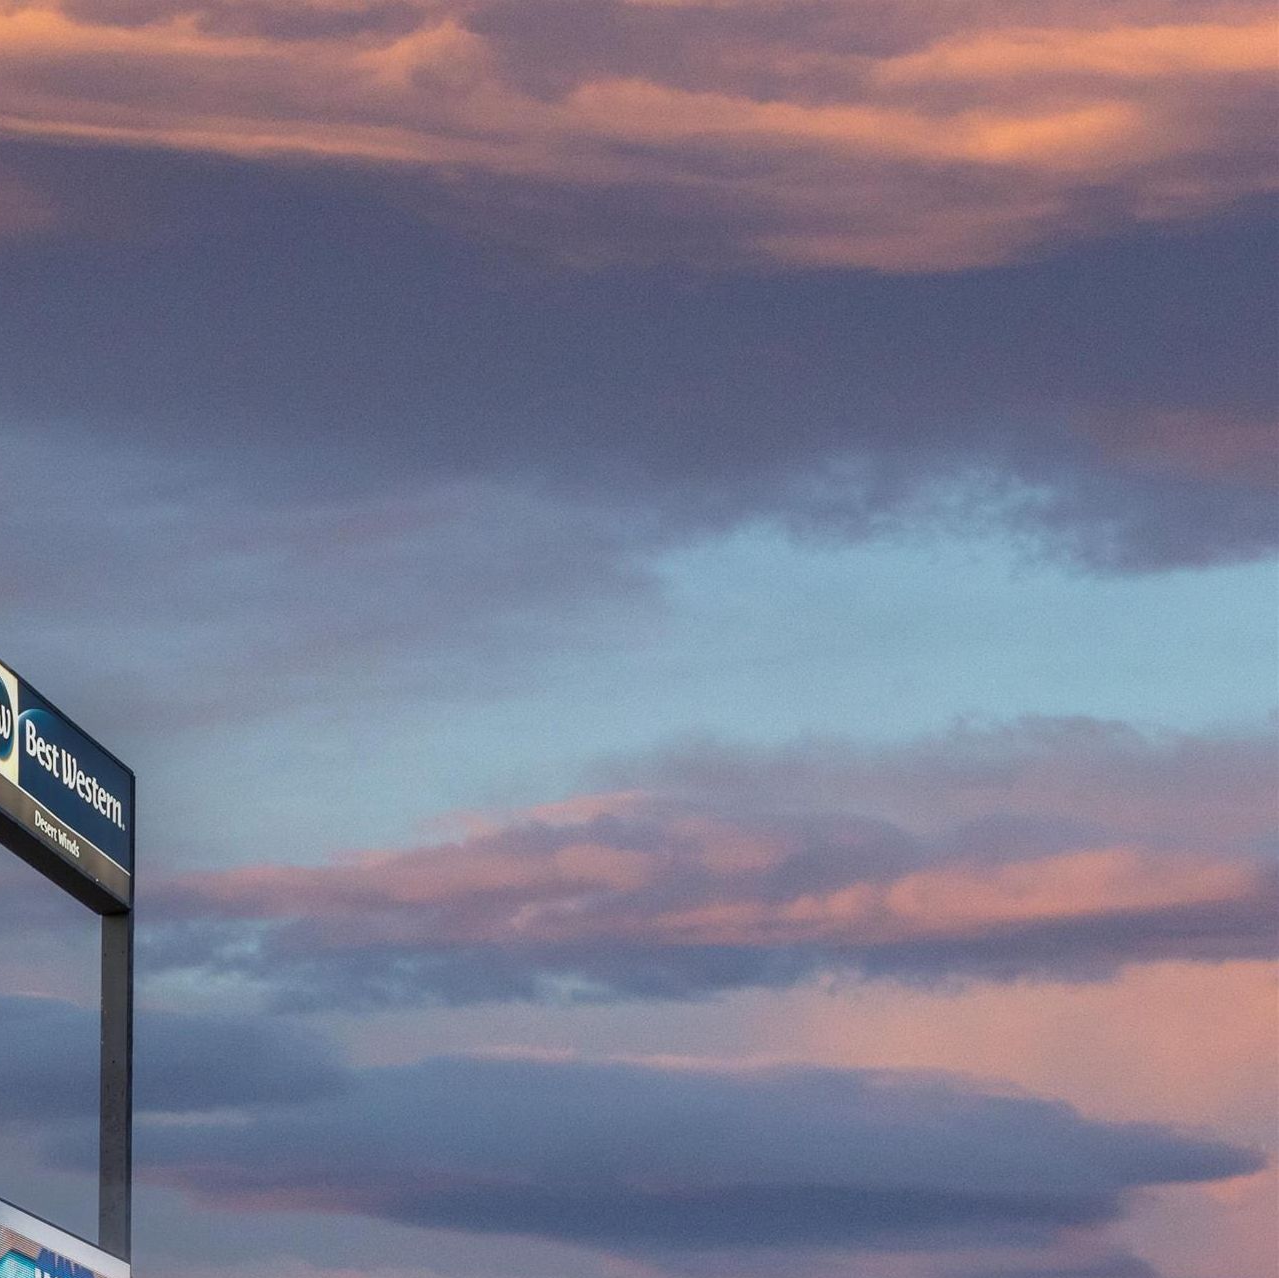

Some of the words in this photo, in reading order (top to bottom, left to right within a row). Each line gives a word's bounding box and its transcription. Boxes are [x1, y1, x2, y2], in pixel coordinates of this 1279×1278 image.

[26, 719, 59, 778] Best
[62, 750, 123, 827] Western
[35, 810, 57, 840] Desert
[59, 832, 80, 857] Winds
